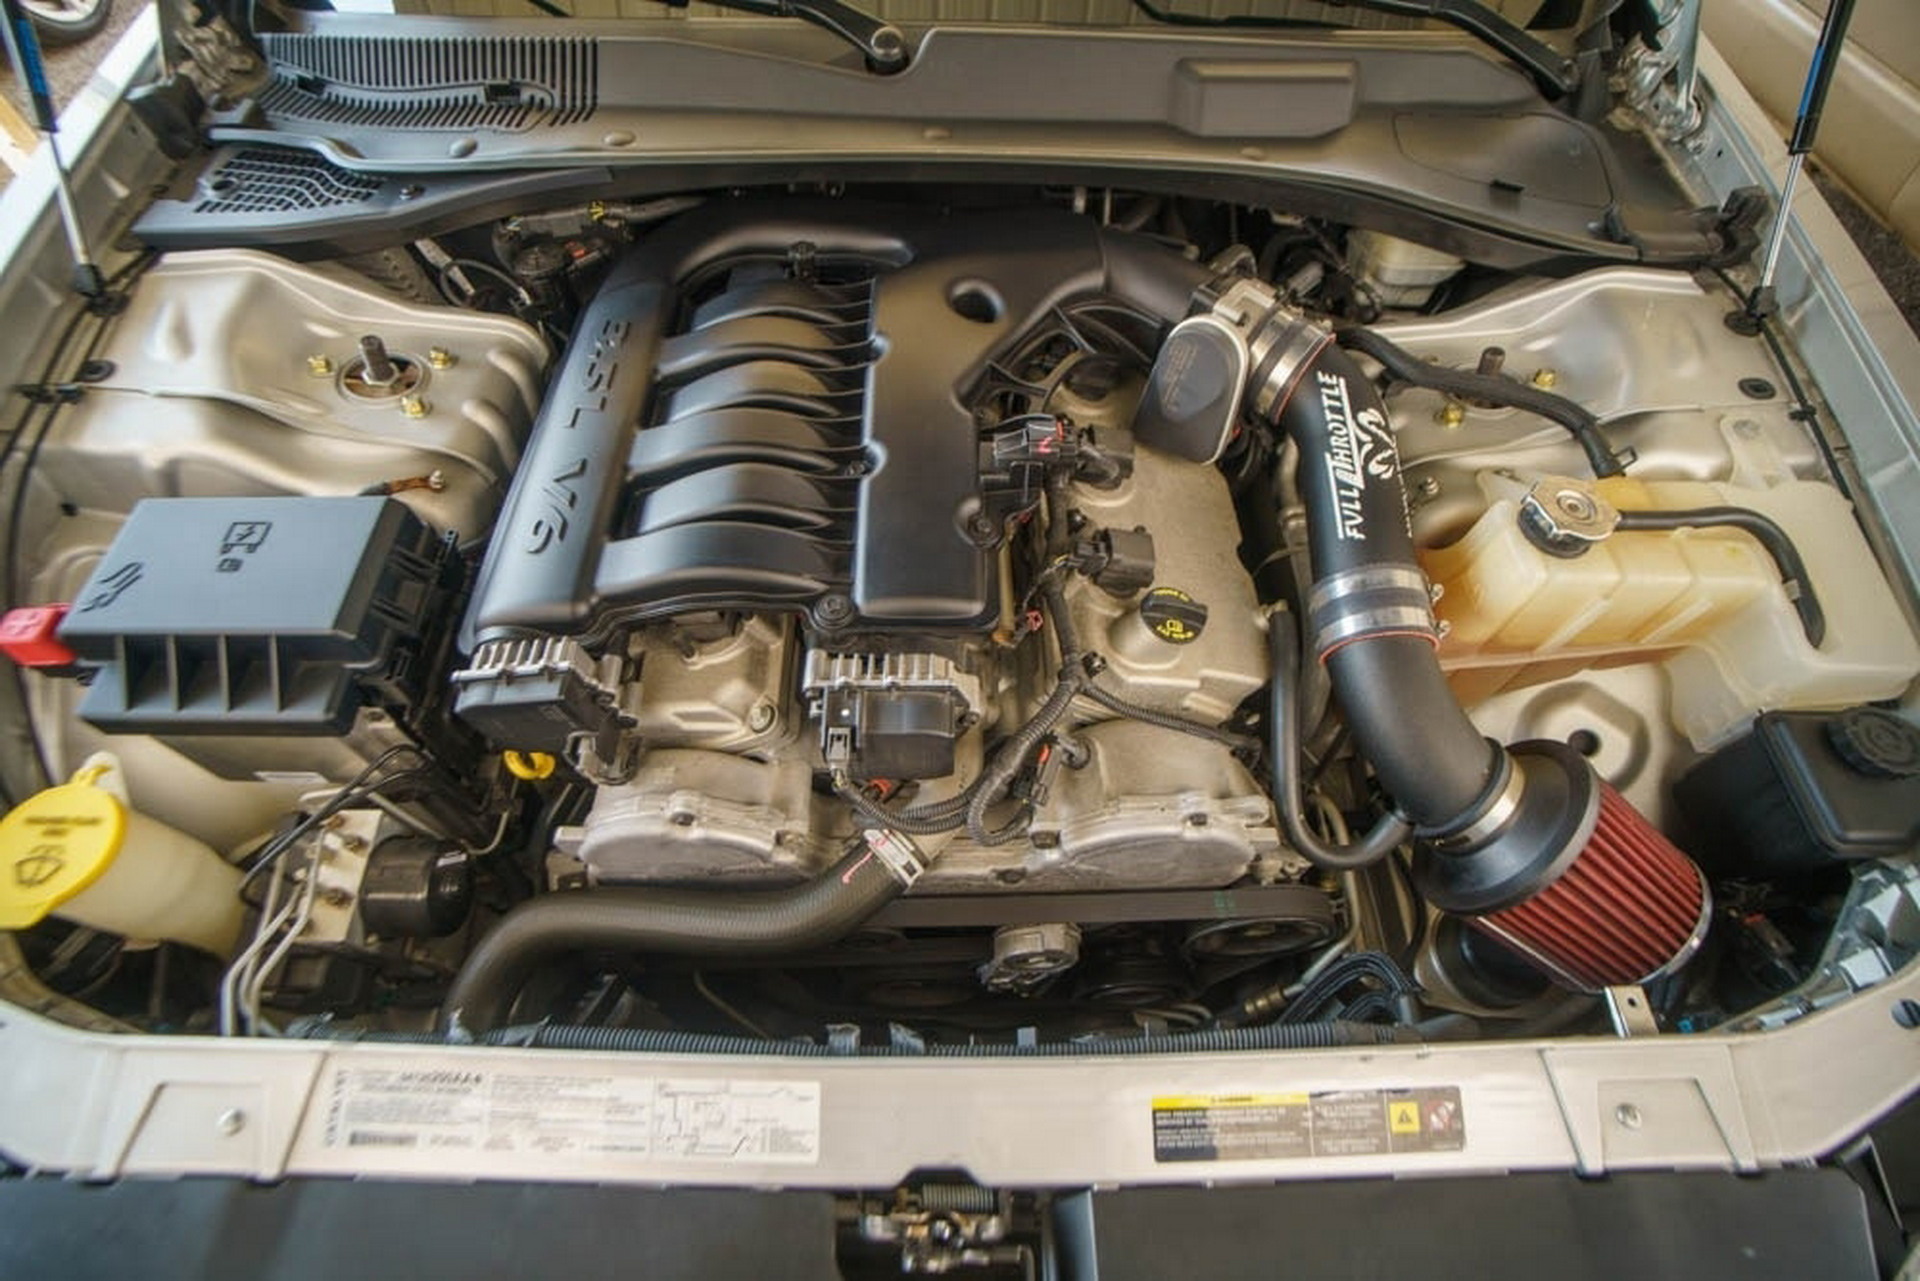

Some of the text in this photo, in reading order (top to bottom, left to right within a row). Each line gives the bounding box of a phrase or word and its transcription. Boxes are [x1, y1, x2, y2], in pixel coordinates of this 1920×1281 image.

[527, 319, 631, 555] 3.5L V6
[1316, 369, 1367, 540] FULL THROTTLE
